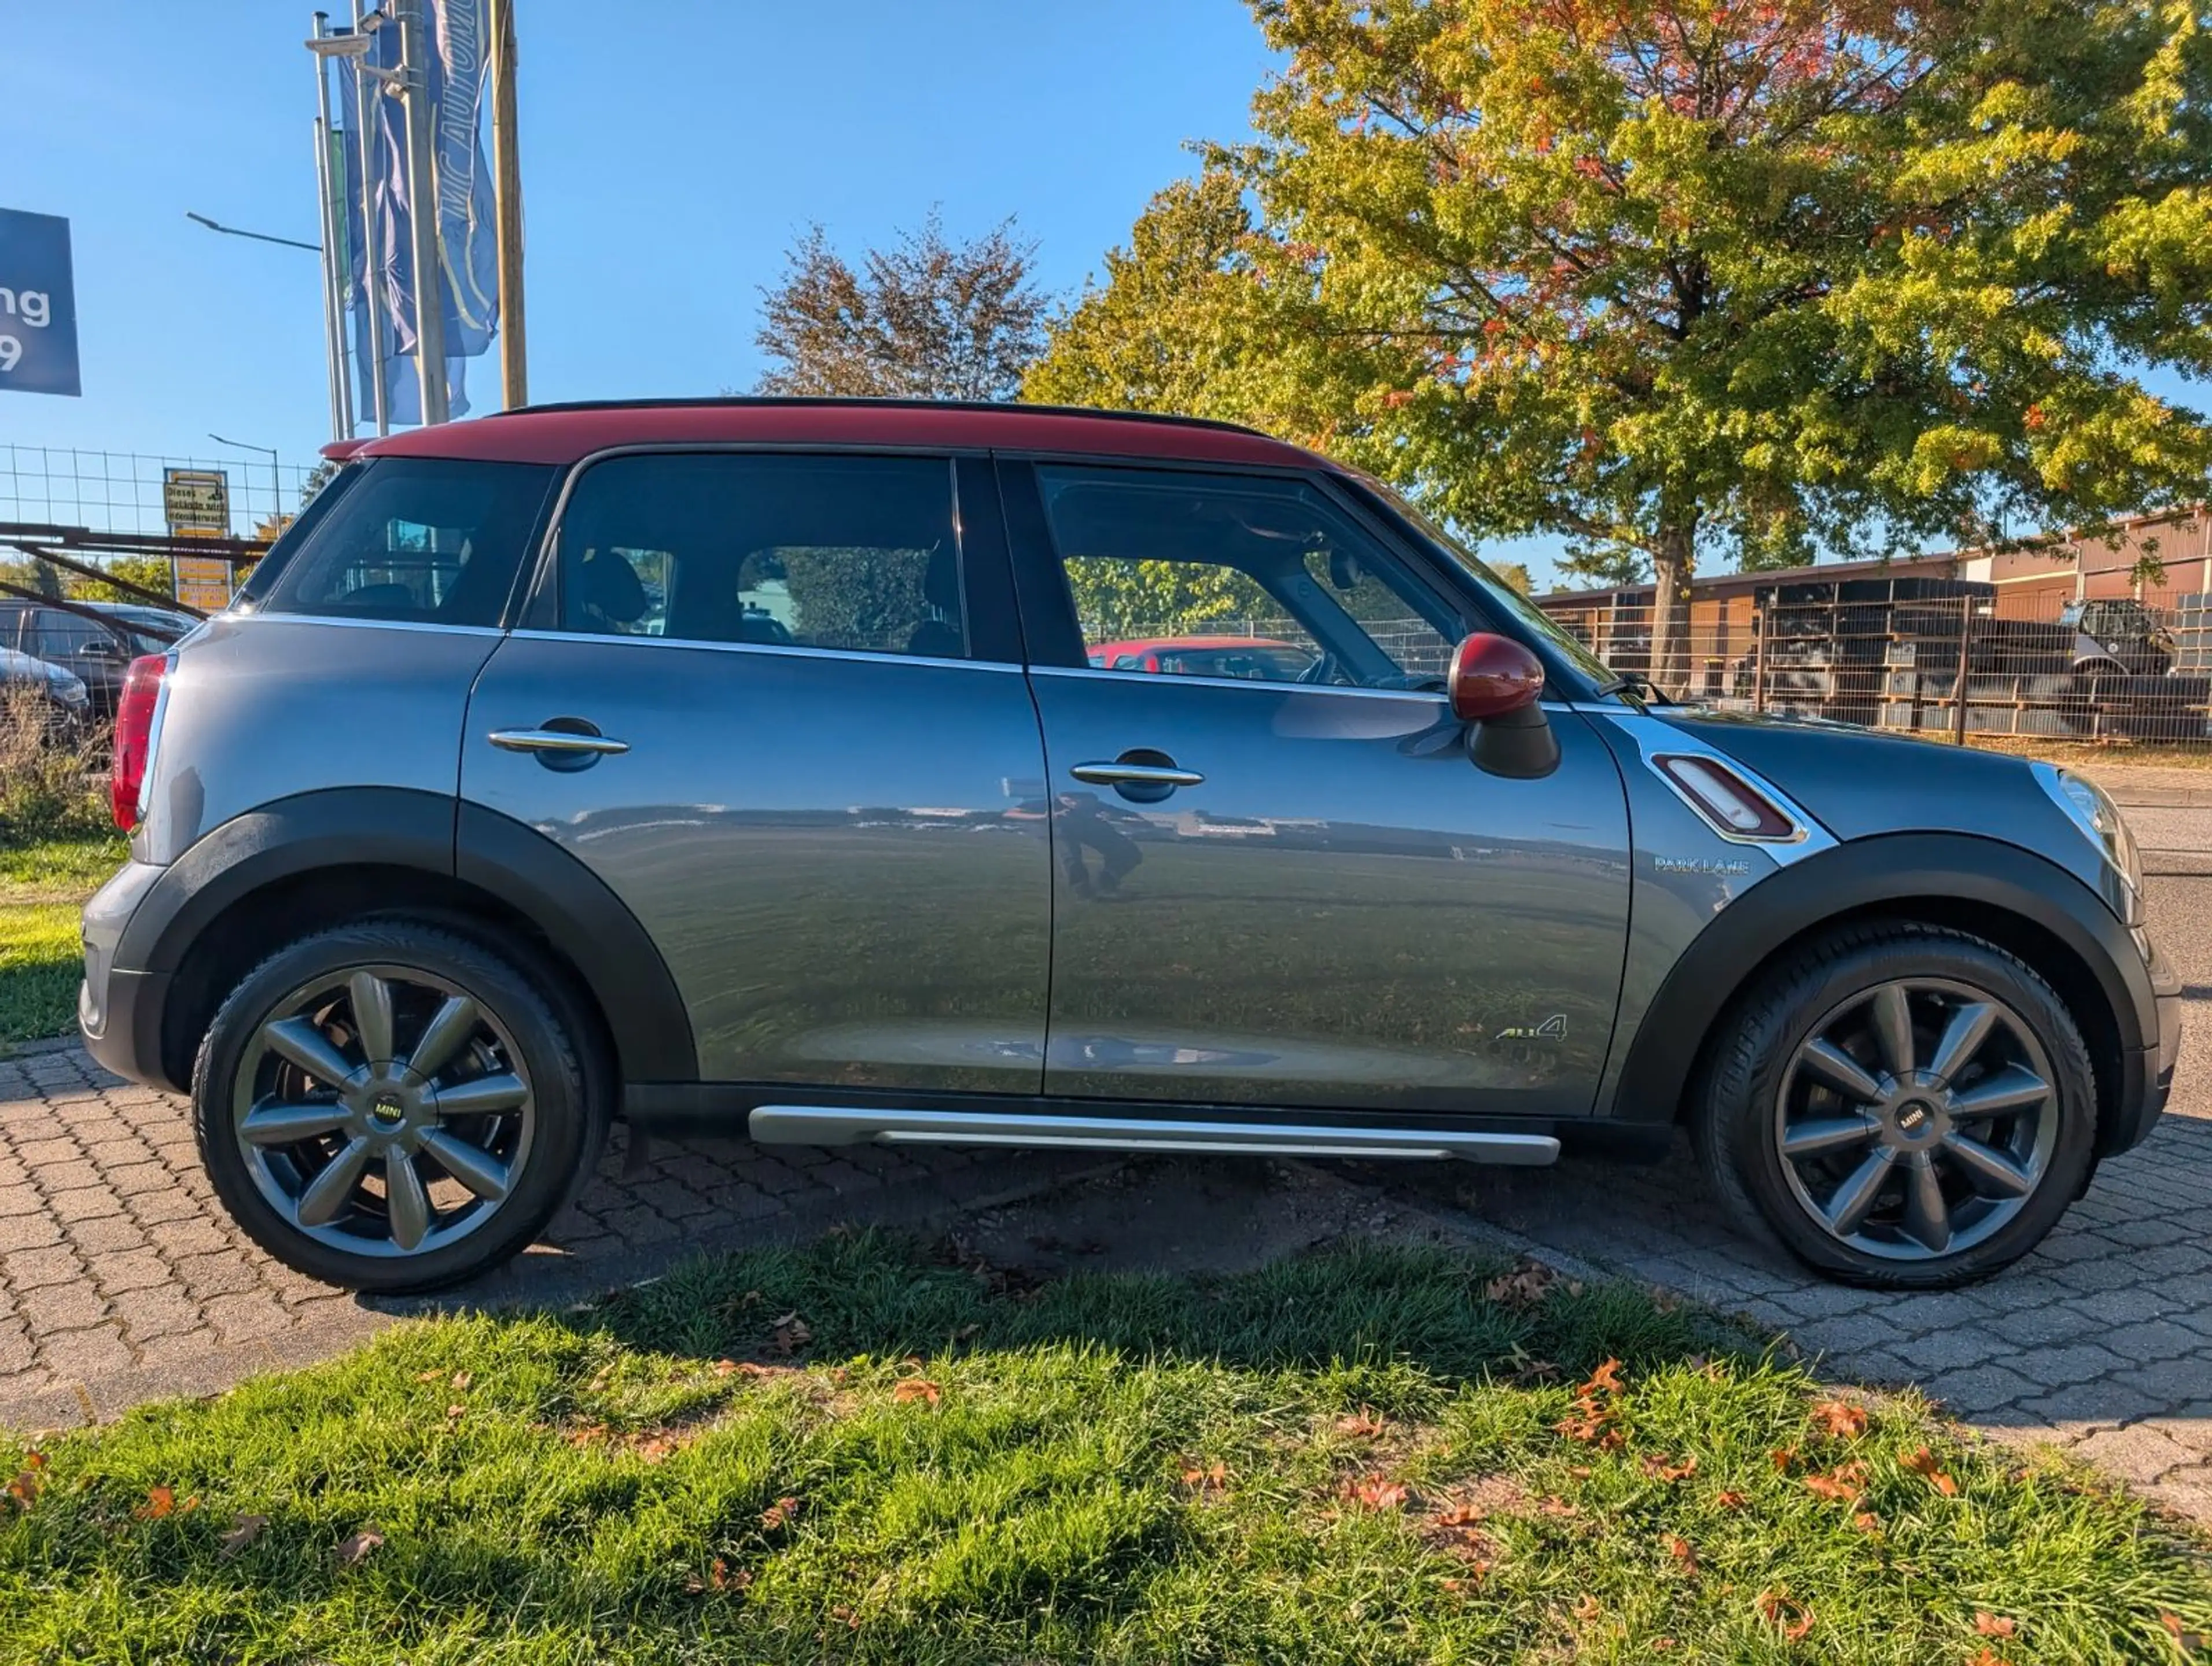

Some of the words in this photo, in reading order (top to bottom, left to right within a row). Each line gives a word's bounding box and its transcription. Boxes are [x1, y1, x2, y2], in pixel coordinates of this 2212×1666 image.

[439, 150, 470, 219] MIC
[0, 334, 22, 371] 9
[1655, 856, 1699, 873] PARK
[1703, 859, 1750, 875] LANE
[375, 1103, 402, 1118] MINI
[1900, 1109, 1924, 1129] MINI
